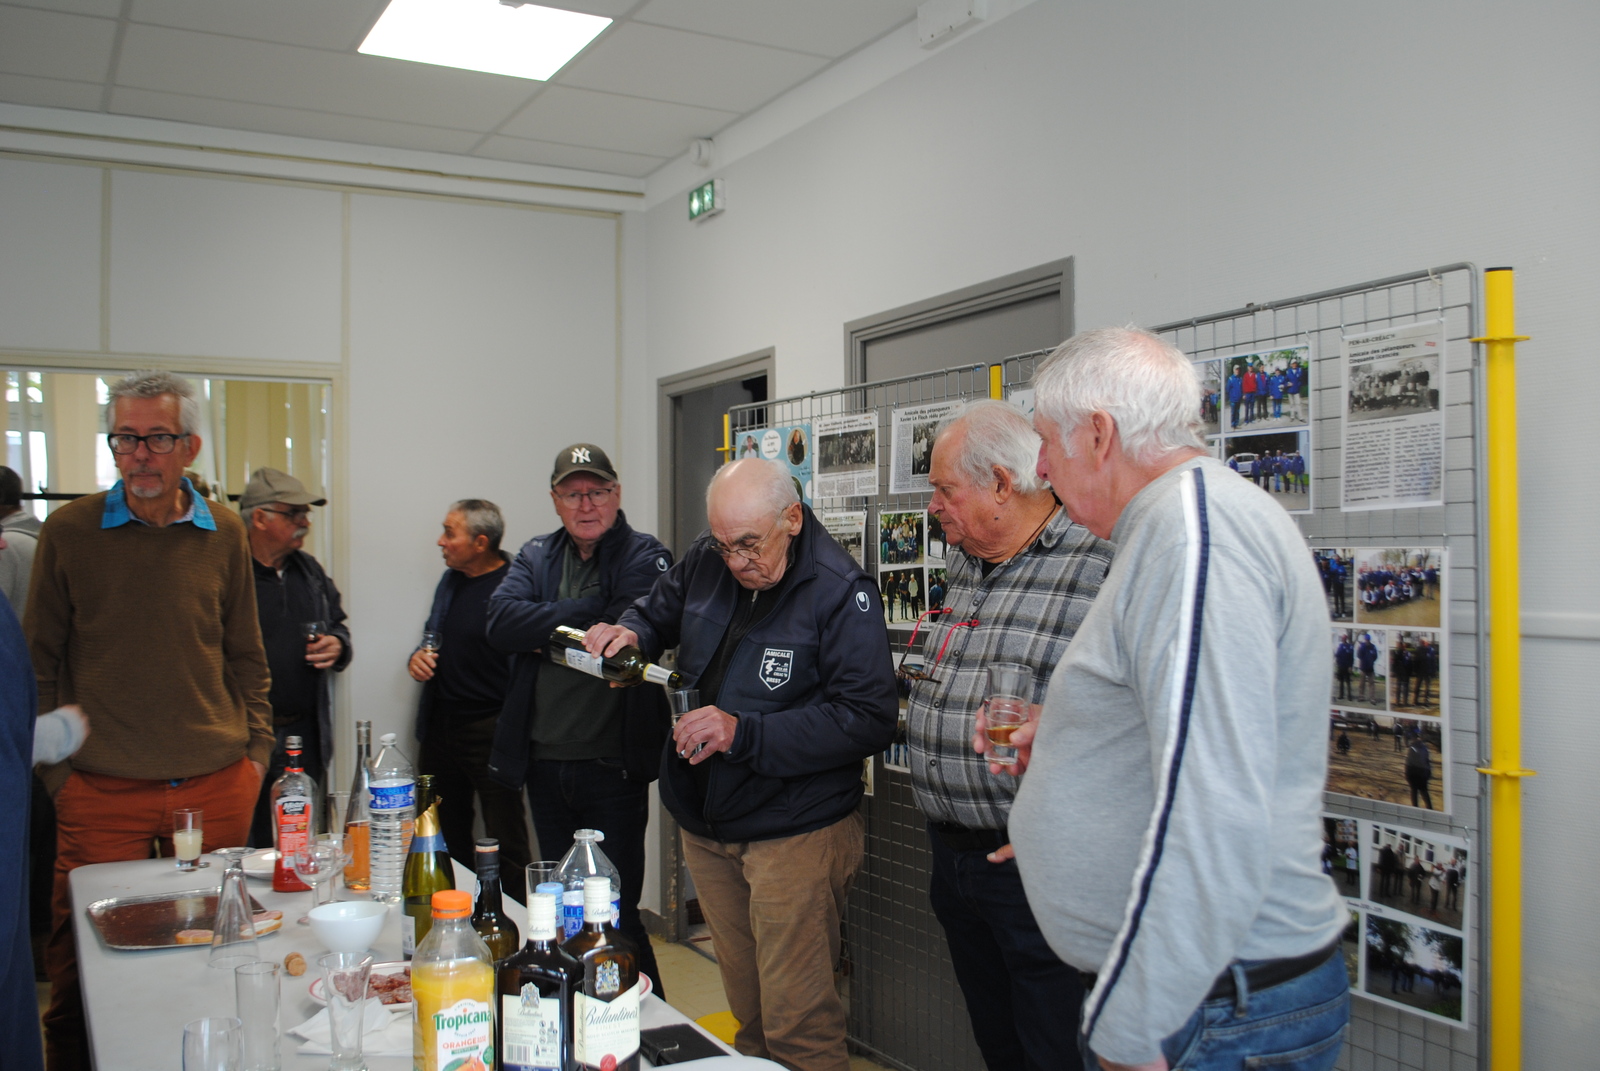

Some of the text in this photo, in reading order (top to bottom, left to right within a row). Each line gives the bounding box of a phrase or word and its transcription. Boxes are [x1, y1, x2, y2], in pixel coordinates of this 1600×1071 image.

[1349, 350, 1370, 358] Amicale
[1349, 352, 1399, 364] Cinquante licenciés
[571, 447, 592, 464] NY
[433, 1008, 492, 1031] Tropicana
[586, 1005, 639, 1026] Ballantine's
[443, 1037, 477, 1049] ORANGE
